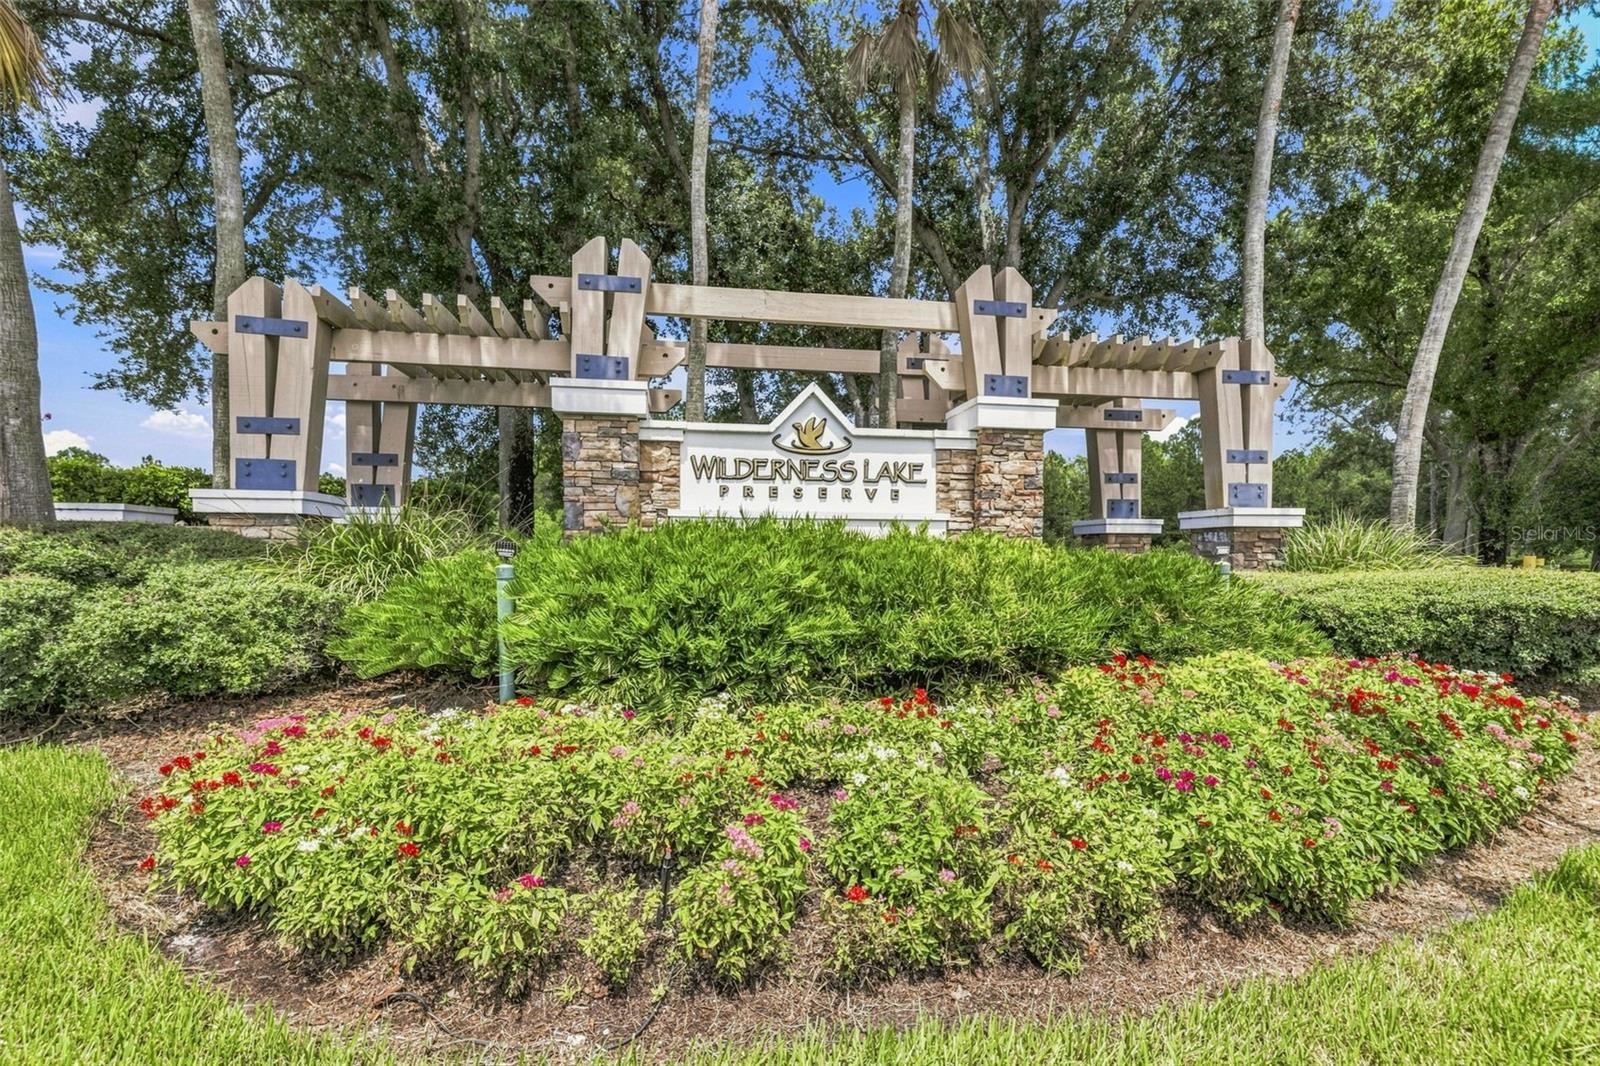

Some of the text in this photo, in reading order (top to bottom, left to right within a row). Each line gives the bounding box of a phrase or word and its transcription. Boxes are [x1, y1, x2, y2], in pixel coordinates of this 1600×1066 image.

[690, 454, 927, 484] WILDERNESS LAKE
[719, 485, 900, 500] PRESERVE
